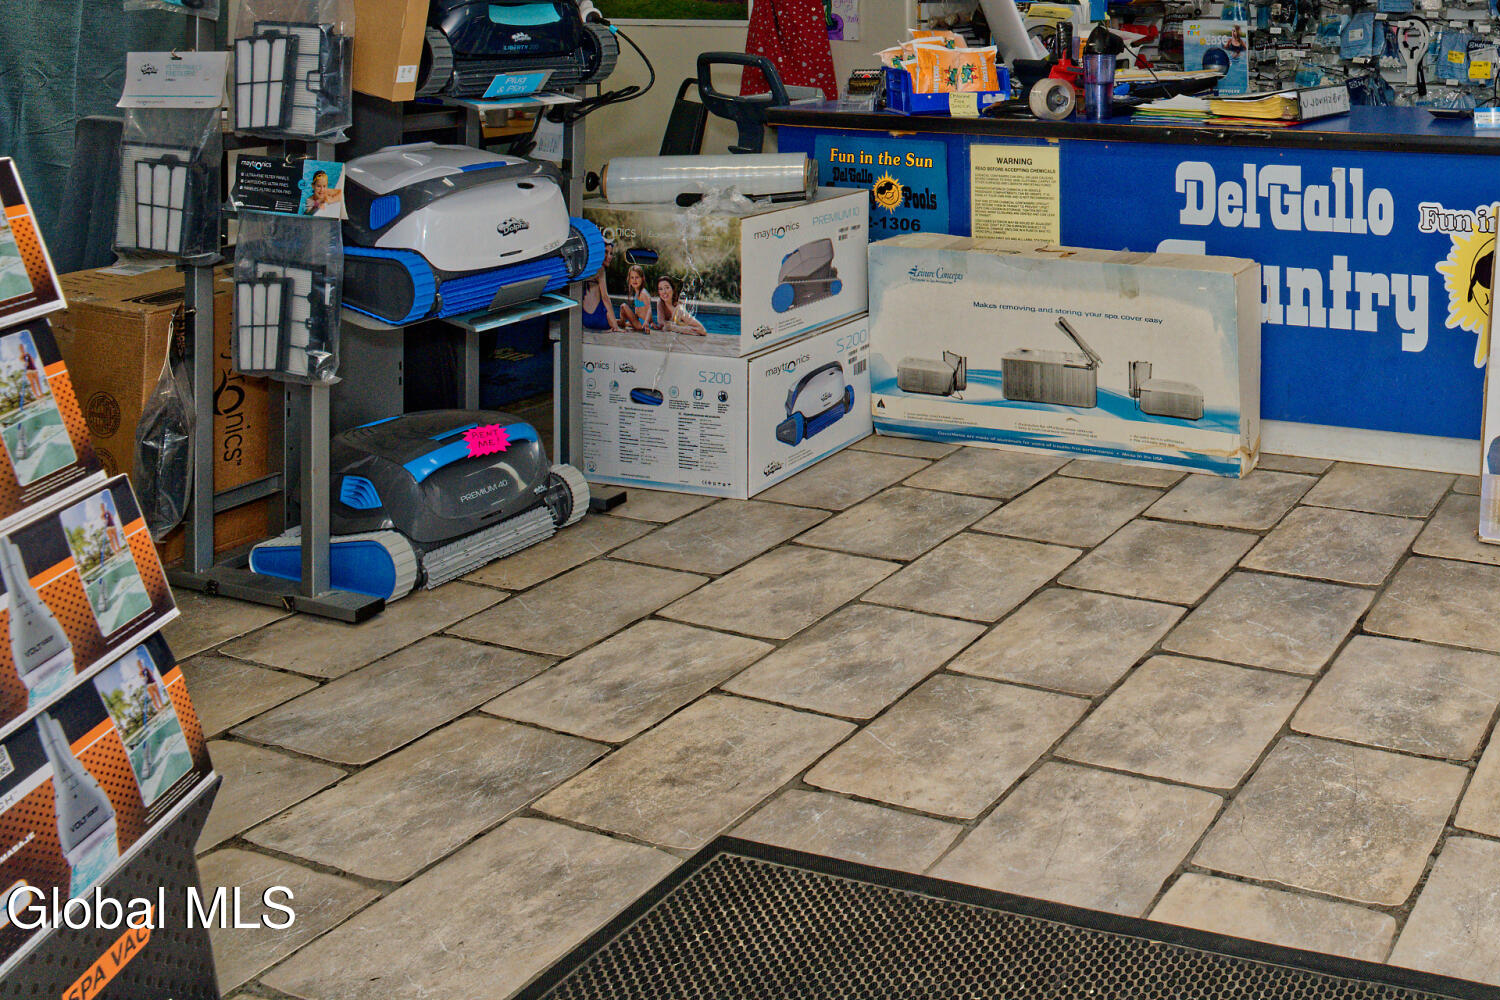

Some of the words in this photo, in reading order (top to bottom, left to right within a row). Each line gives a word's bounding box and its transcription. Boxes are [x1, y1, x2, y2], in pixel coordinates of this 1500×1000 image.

[830, 148, 855, 164] Fun
[860, 152, 873, 164] in
[878, 151, 900, 165] the
[905, 153, 933, 168] Sun
[996, 157, 1032, 165] WARNING
[902, 186, 937, 210] Pools
[1175, 161, 1394, 235] DelGallo
[1419, 206, 1472, 232] Fun
[753, 222, 800, 240] maytronics
[936, 268, 964, 282] Concepts
[973, 301, 998, 310] Makes
[999, 303, 1036, 313] removing
[1055, 308, 1082, 317] storing
[1104, 312, 1118, 320] spa
[1144, 317, 1163, 325] easy
[1261, 255, 1429, 352] untry
[472, 429, 499, 440] RENT
[460, 485, 498, 503] PREMIUM
